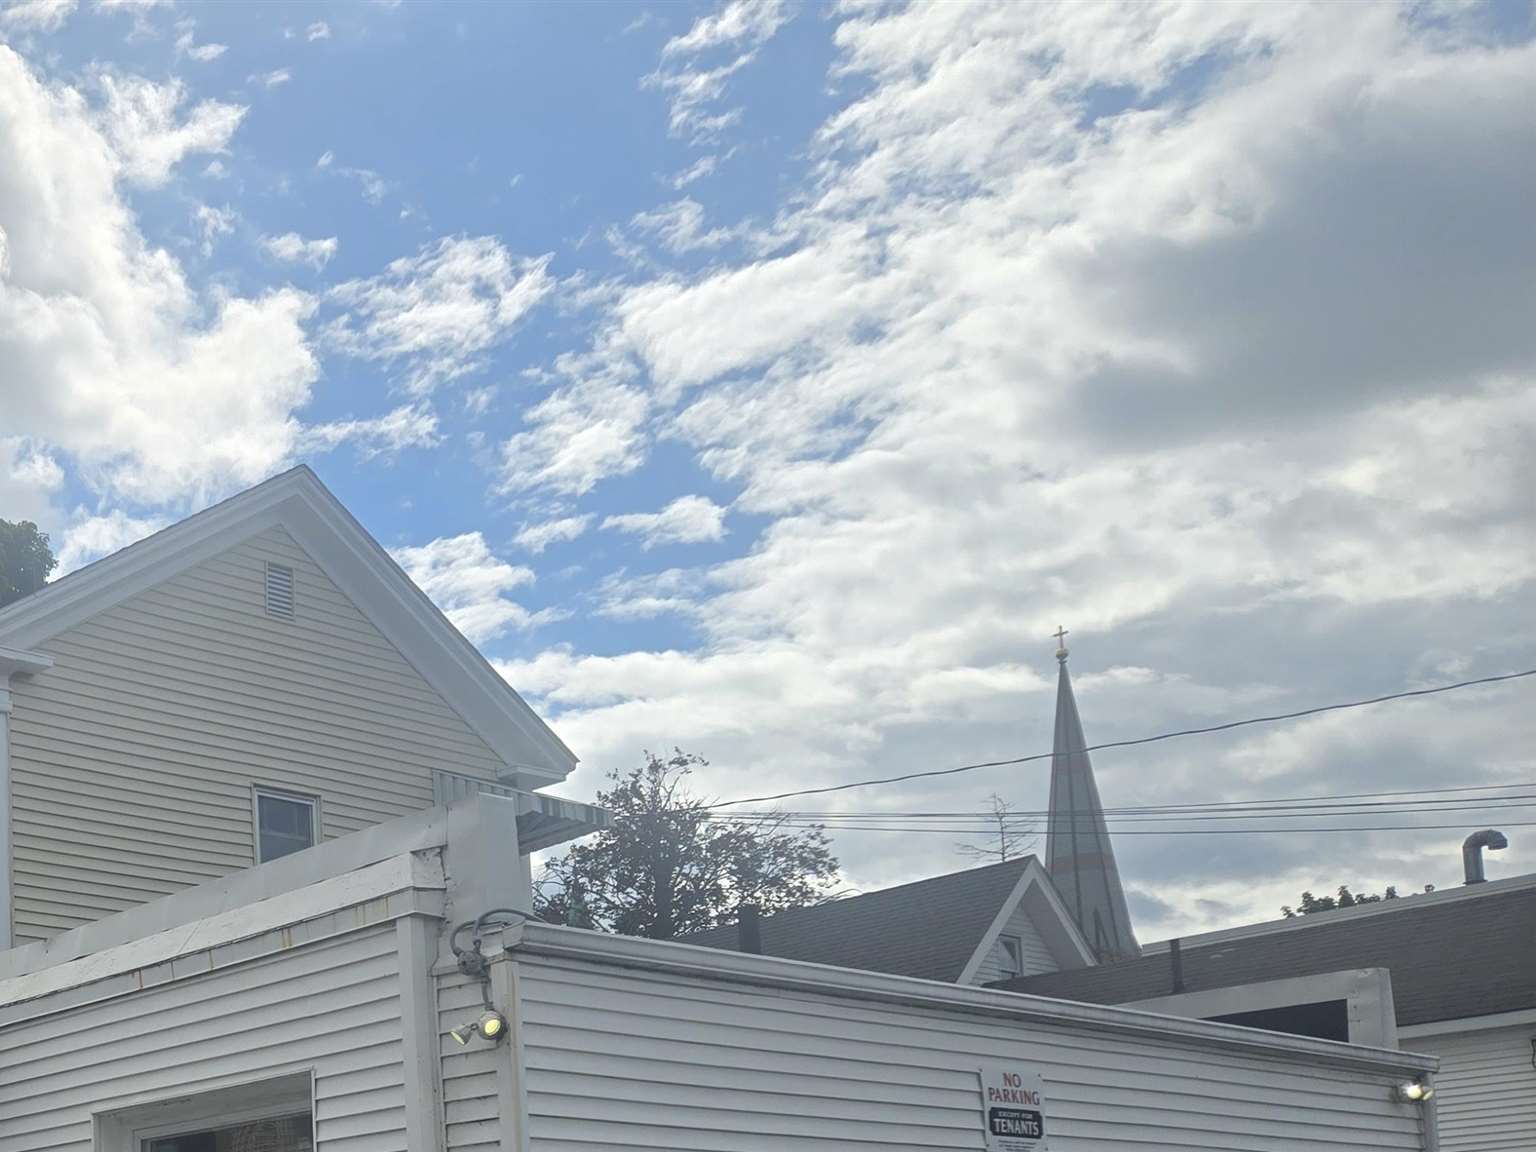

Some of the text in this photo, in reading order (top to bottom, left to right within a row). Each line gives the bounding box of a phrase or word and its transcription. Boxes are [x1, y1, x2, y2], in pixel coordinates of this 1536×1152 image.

[1002, 1072, 1022, 1088] NO
[988, 1087, 1040, 1106] PARKING
[993, 1118, 1040, 1136] TENANTS
